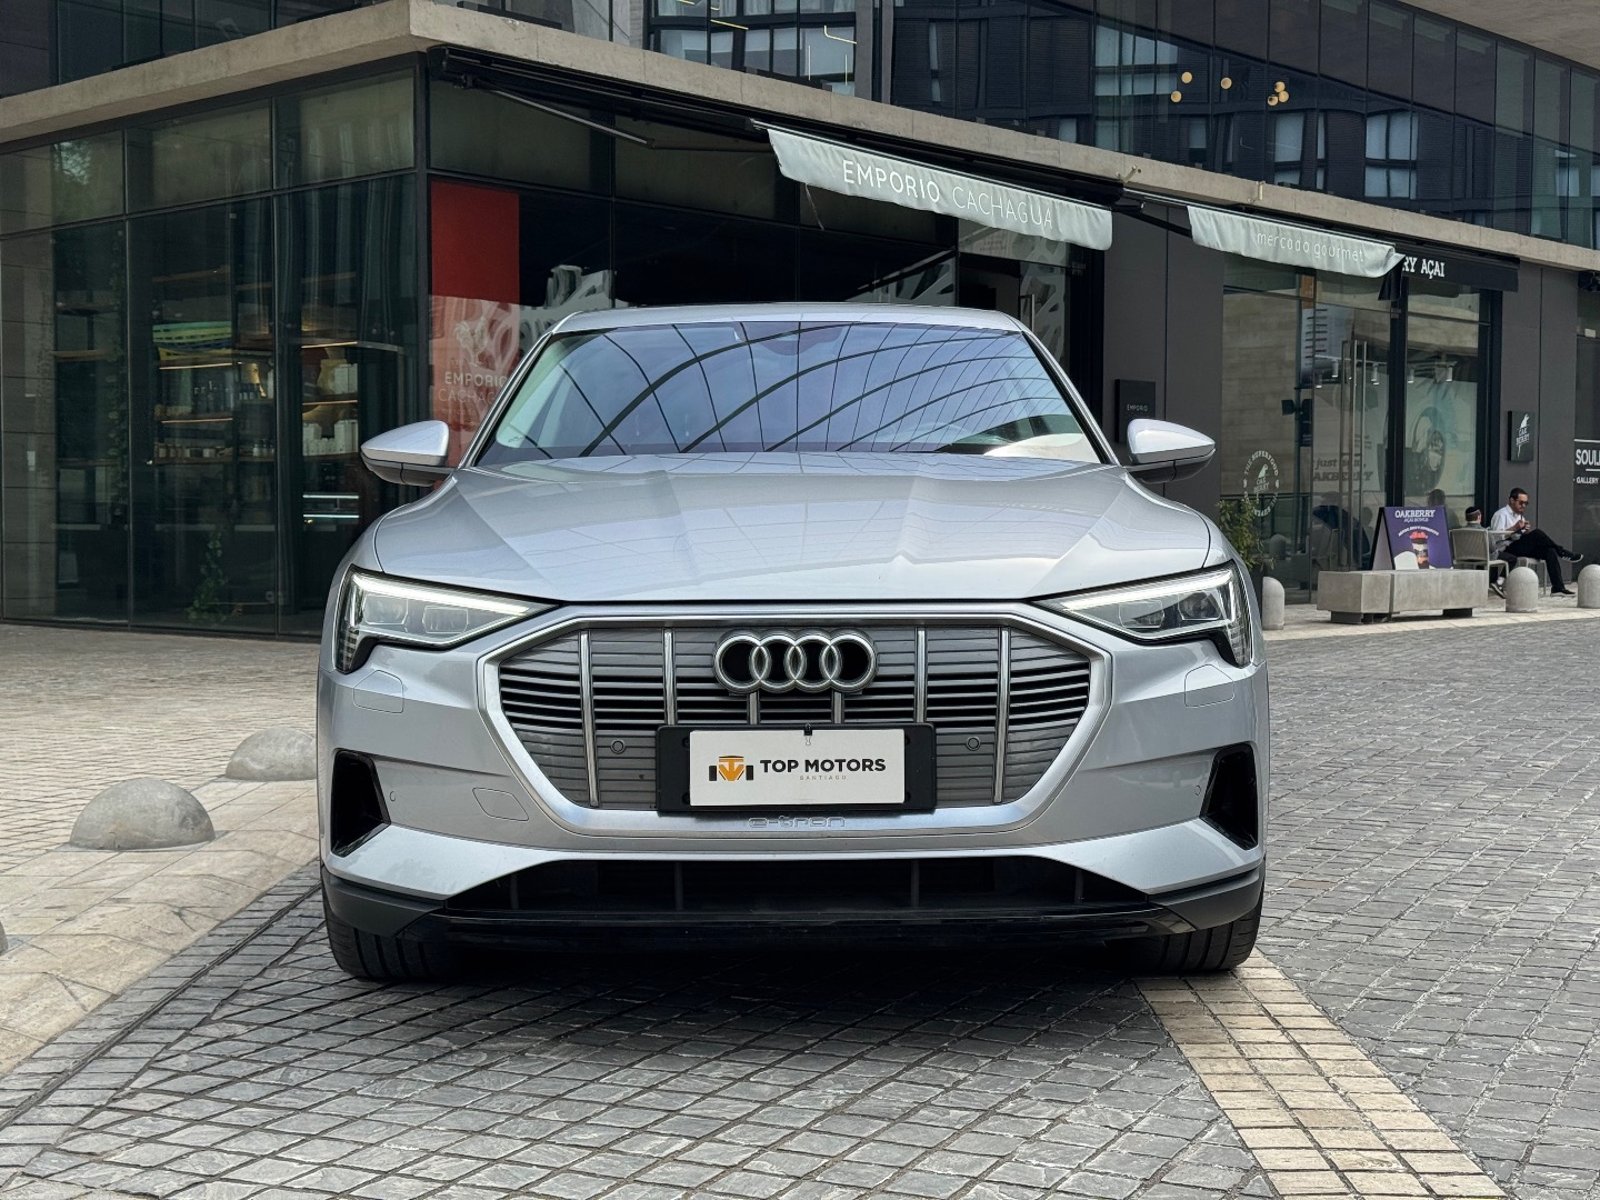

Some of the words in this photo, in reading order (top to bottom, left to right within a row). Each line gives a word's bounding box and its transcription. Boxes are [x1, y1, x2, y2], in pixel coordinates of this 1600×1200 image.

[842, 159, 940, 203] EMPORIO
[952, 186, 1053, 230] CACHAGUA
[1257, 231, 1310, 254] mercado
[1314, 242, 1365, 263] gourmet
[1421, 258, 1445, 280] AÇAI
[1394, 509, 1436, 518] OAKBERRY
[760, 760, 798, 773] TOP
[804, 758, 886, 773] MOTORS
[749, 815, 846, 828] e-tron
